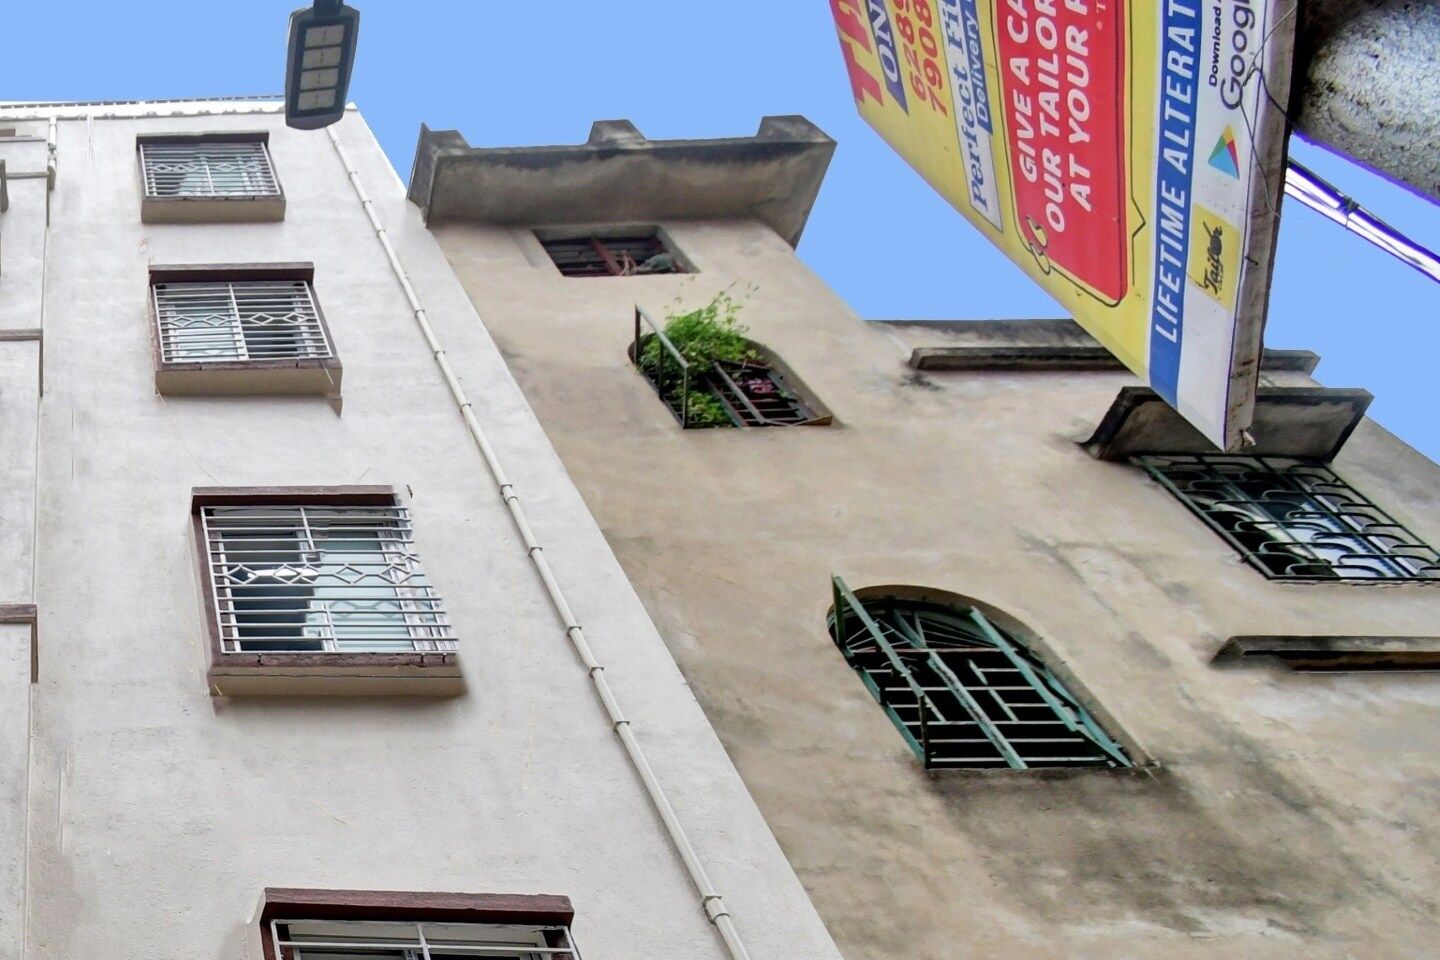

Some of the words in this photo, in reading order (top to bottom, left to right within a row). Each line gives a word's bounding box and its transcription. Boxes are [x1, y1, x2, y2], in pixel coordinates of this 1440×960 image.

[964, 12, 989, 125] Delivery
[1010, 57, 1030, 86] A
[1065, 25, 1090, 143] YOUR
[1209, 6, 1222, 87] Download
[954, 65, 988, 212] Perfect
[1013, 89, 1037, 183] GIVE
[1069, 153, 1092, 213] AT
[1042, 148, 1065, 233] OUR
[1155, 180, 1186, 344] LIFETIME
